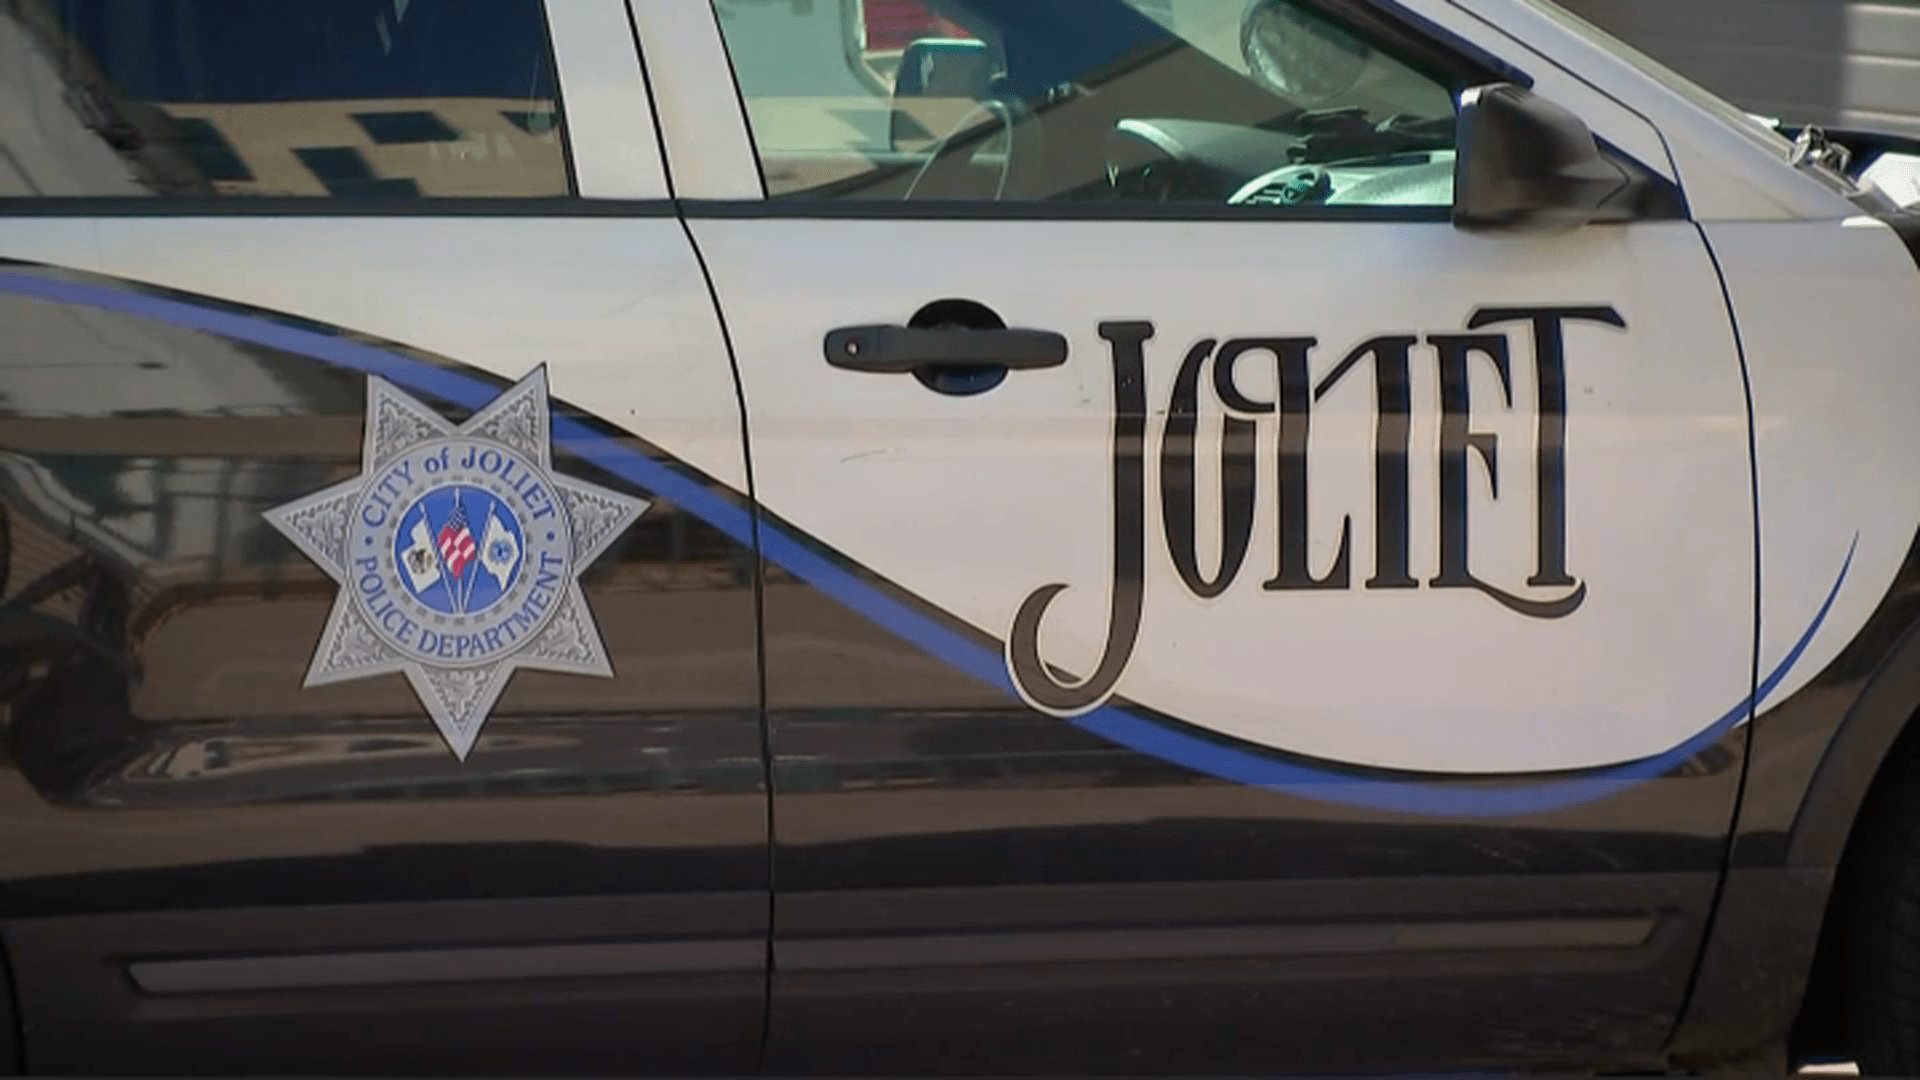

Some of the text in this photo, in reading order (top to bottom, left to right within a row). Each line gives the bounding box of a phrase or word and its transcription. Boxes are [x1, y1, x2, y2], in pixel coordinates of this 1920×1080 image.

[362, 446, 556, 528] CITY of JOLIET
[1009, 305, 1627, 710] JOLIET
[356, 551, 563, 658] POLICE DEPARTMENT
